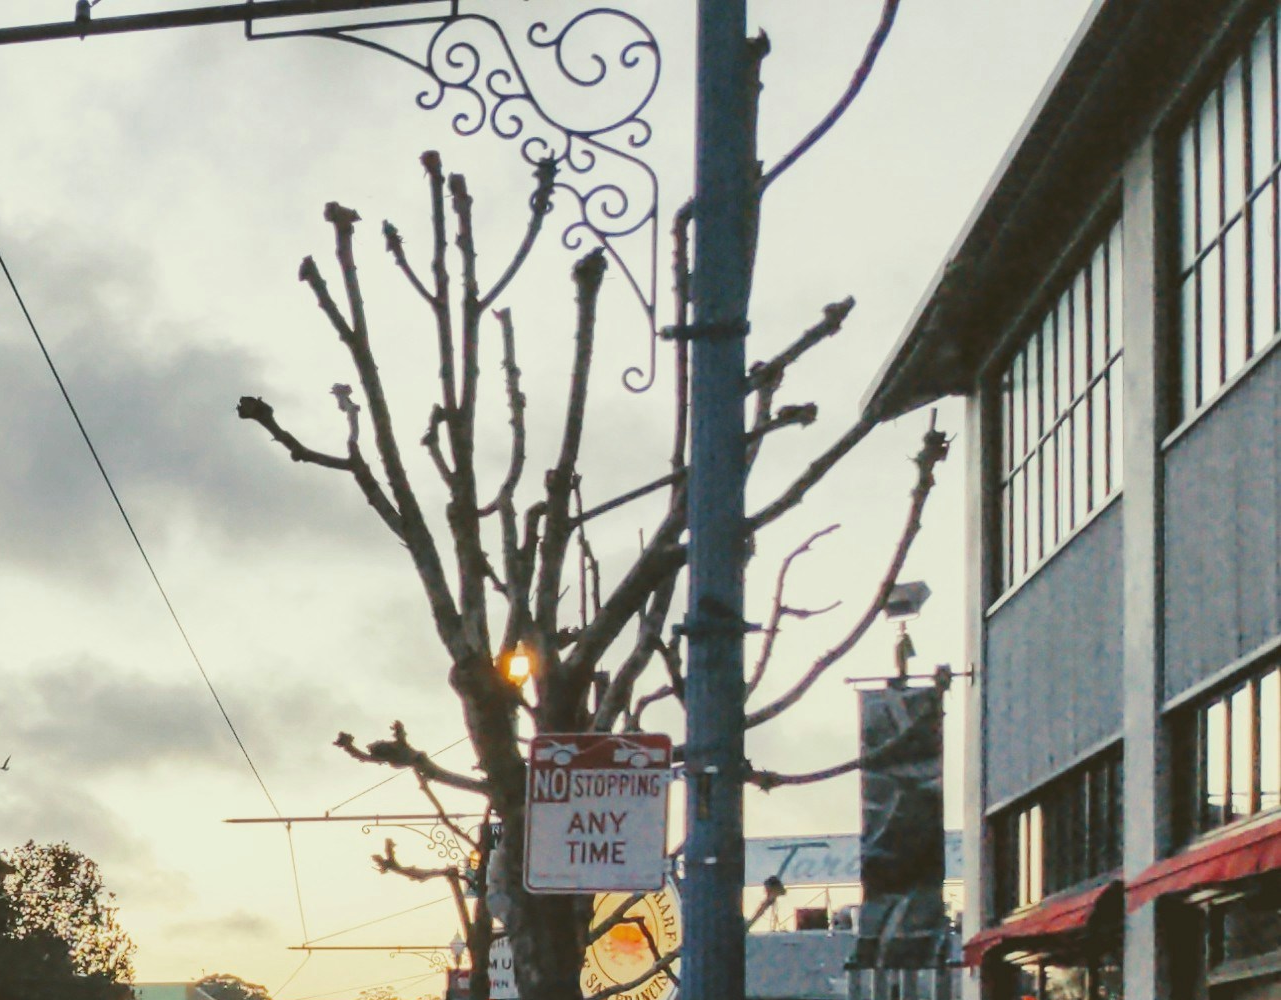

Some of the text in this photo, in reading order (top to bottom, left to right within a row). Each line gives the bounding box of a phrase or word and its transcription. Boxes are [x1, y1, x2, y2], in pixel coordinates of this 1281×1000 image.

[534, 768, 661, 800] NO STOPPING
[567, 811, 628, 835] ANY
[566, 841, 627, 865] TIME
